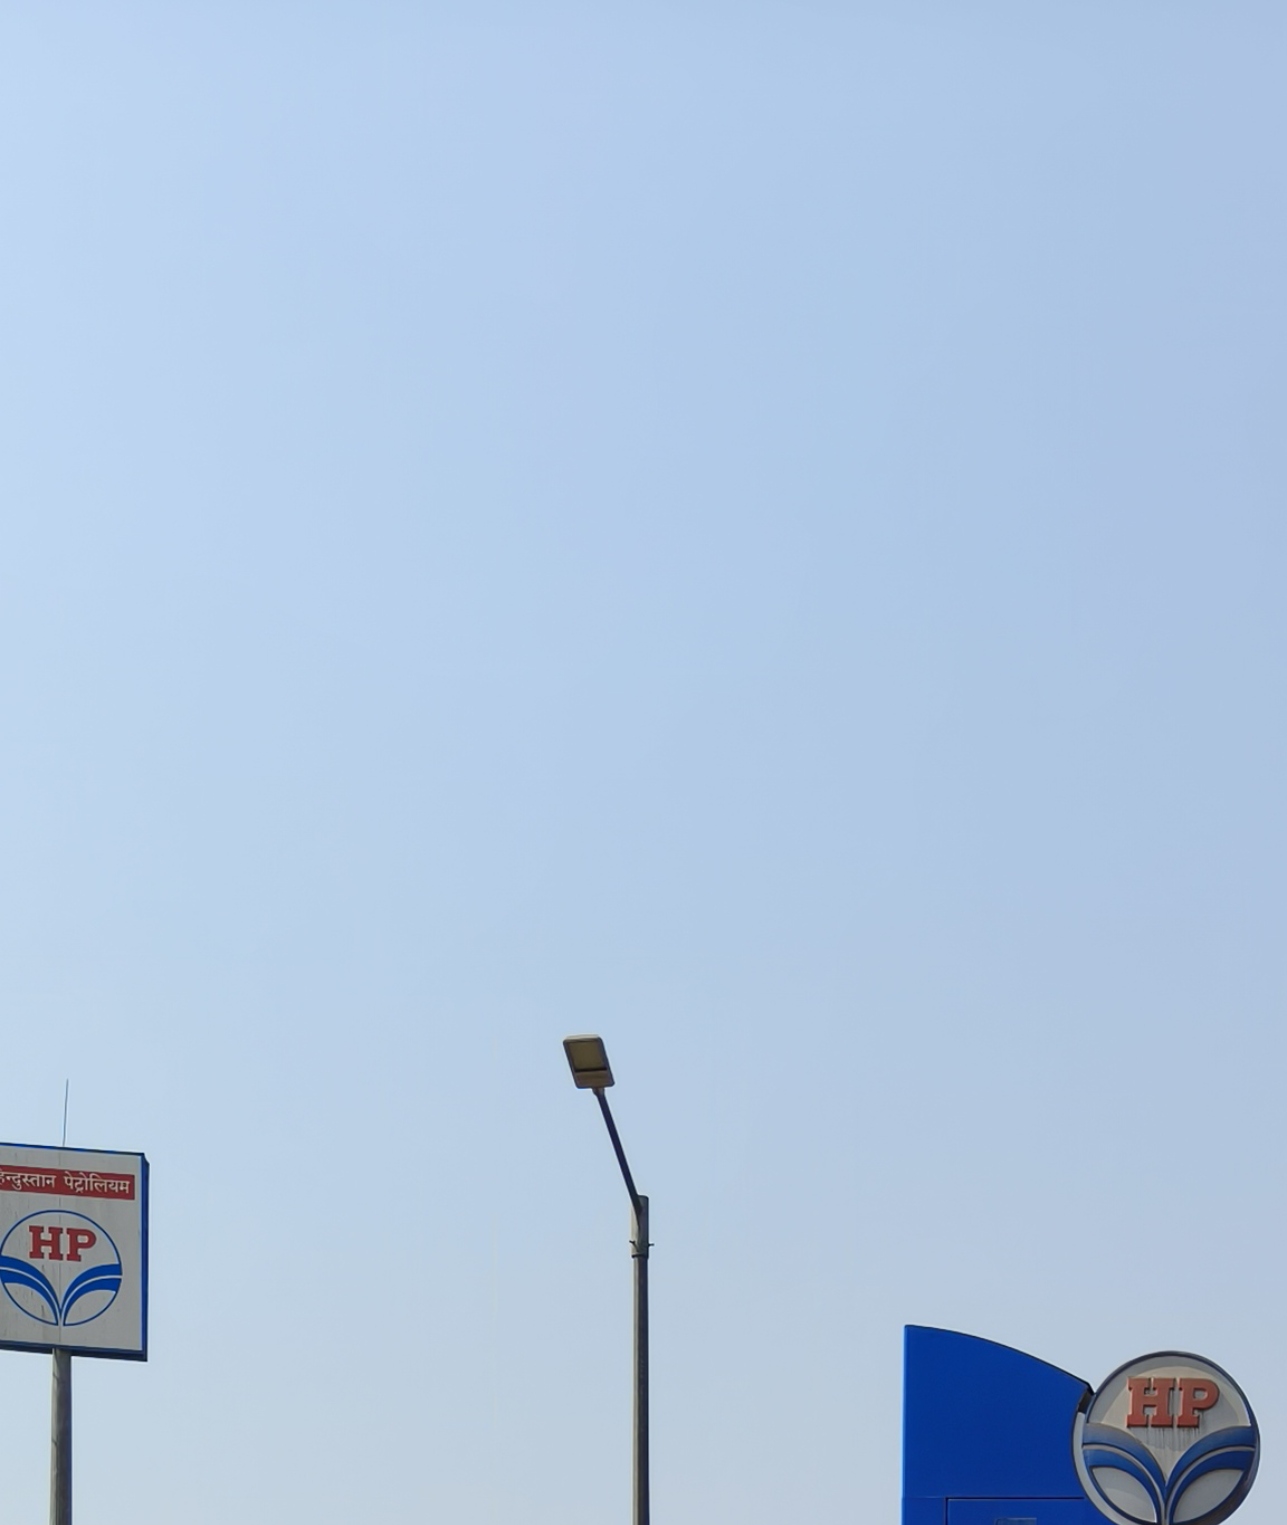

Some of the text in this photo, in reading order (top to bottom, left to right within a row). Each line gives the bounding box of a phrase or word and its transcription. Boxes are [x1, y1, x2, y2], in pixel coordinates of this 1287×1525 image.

[63, 1171, 130, 1194] पेट्रोलियम
[28, 1225, 97, 1262] HP
[1126, 1377, 1220, 1428] HP
